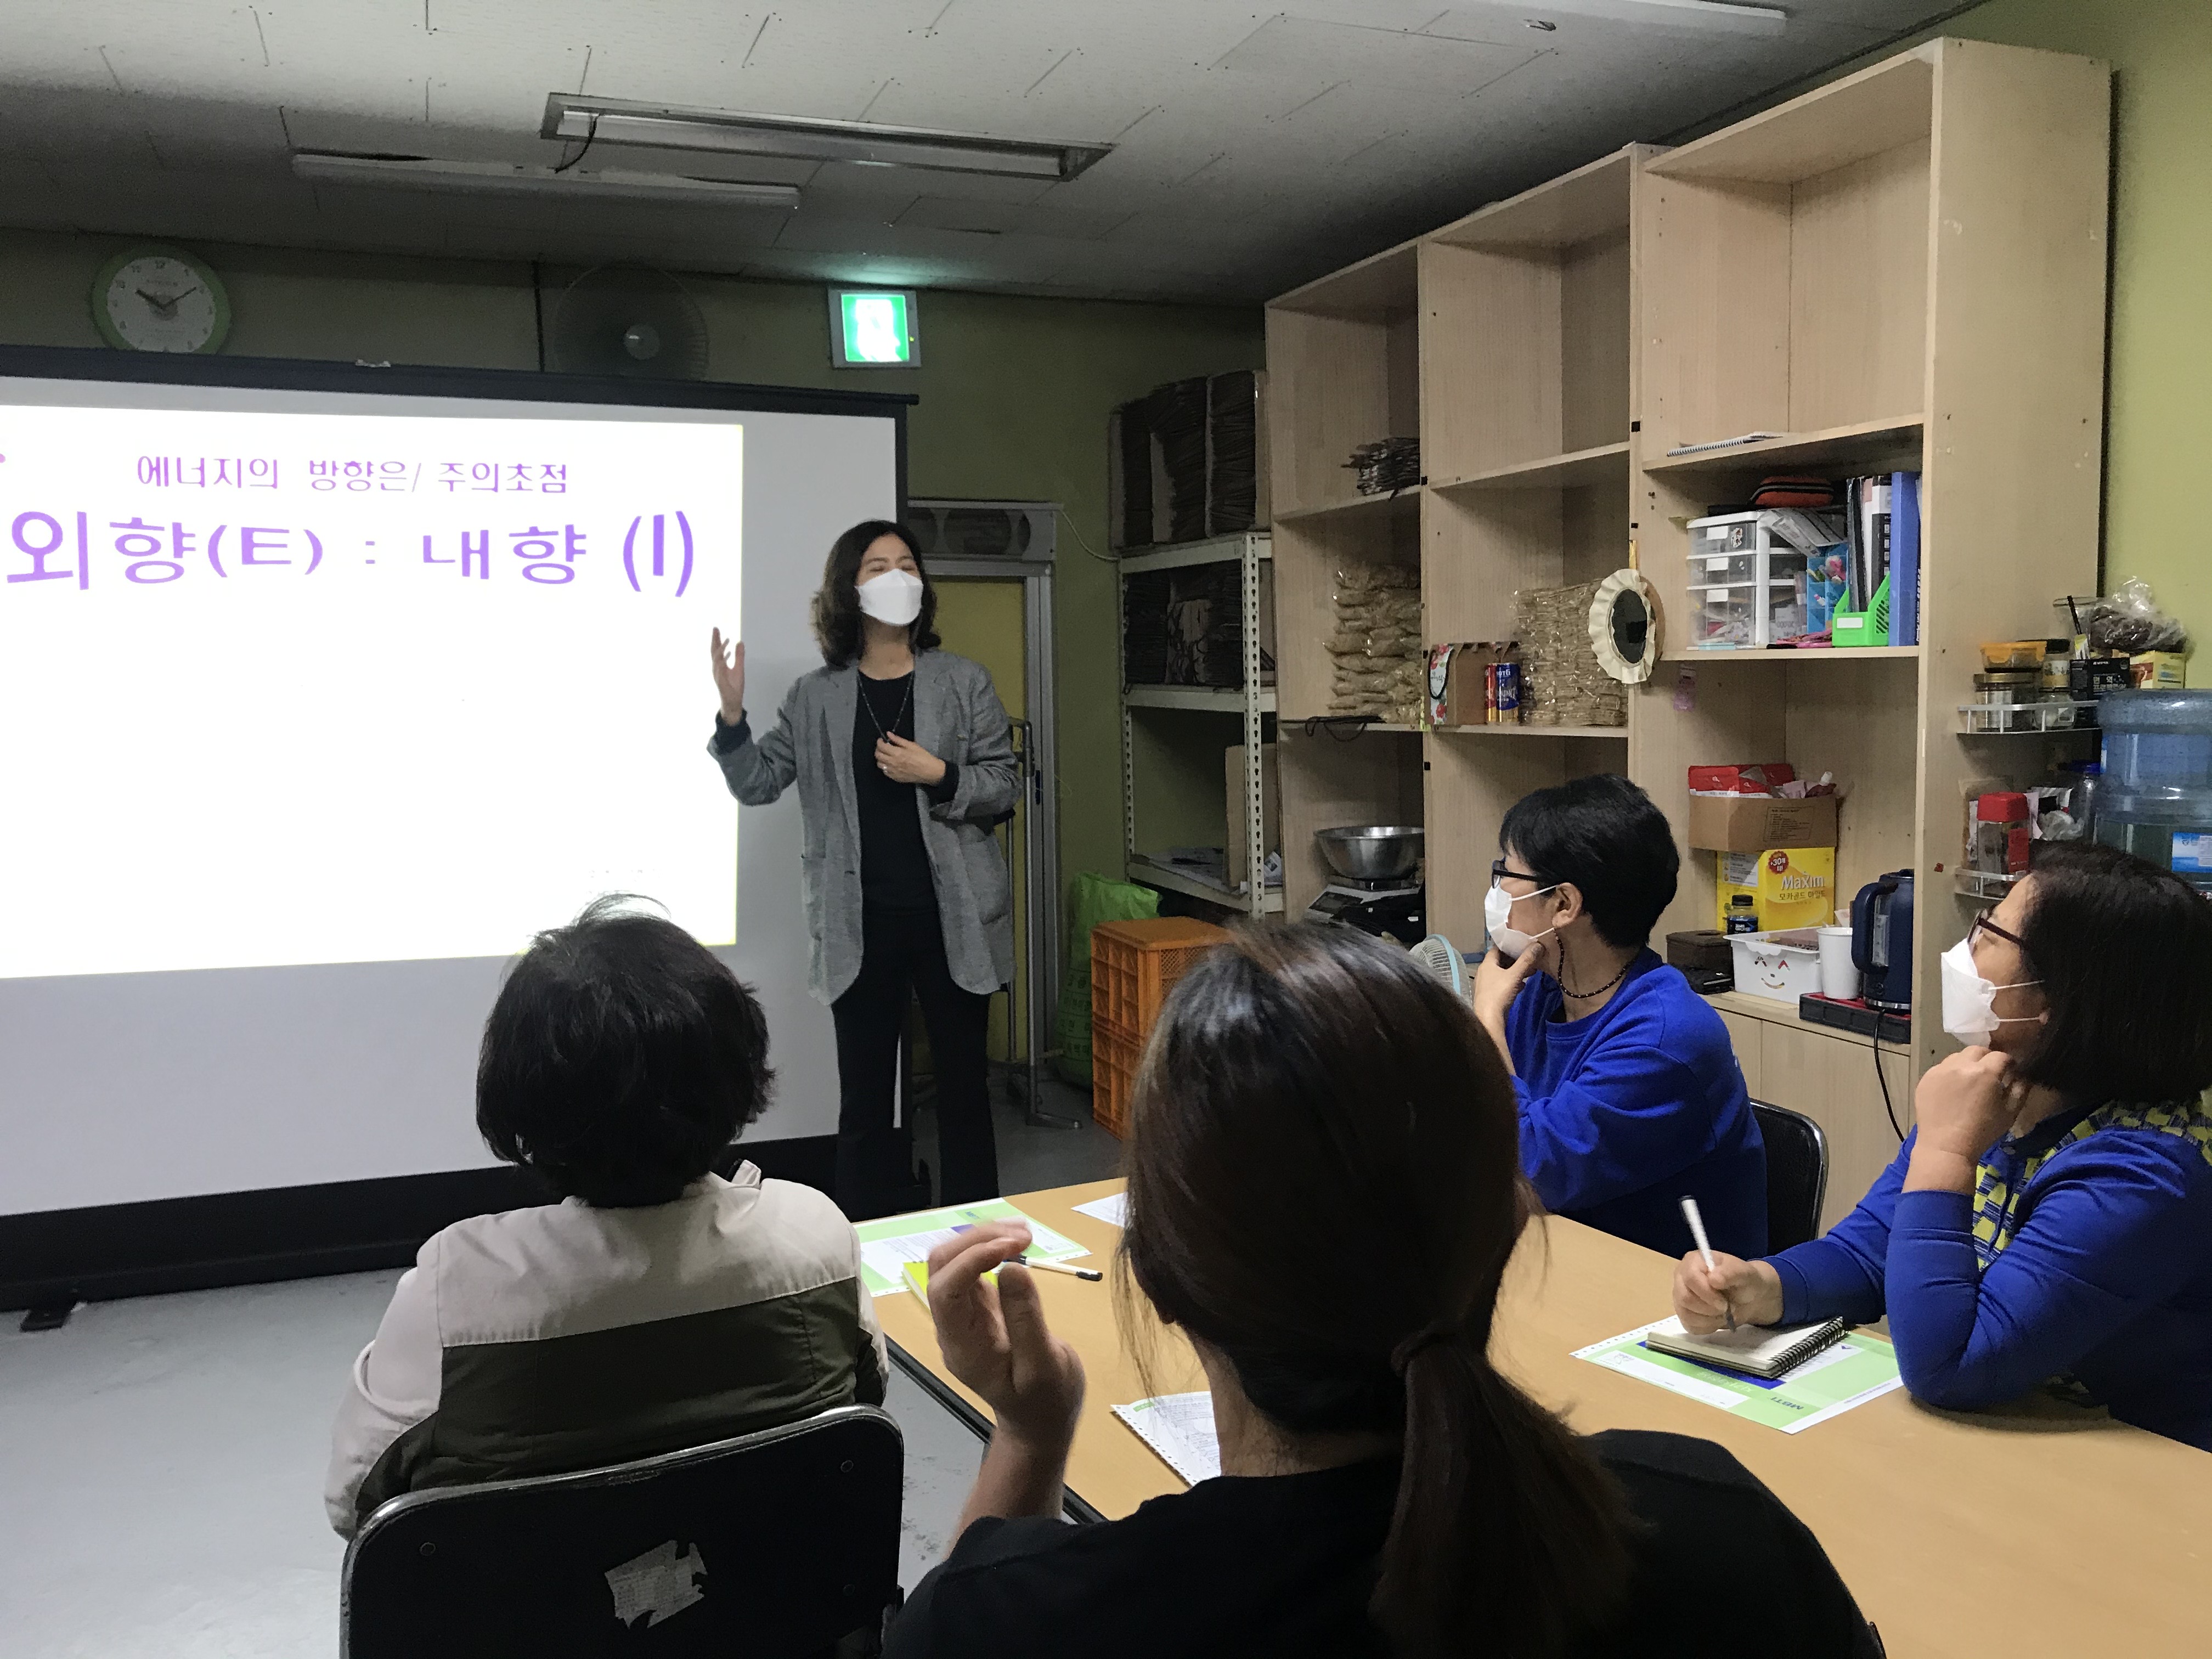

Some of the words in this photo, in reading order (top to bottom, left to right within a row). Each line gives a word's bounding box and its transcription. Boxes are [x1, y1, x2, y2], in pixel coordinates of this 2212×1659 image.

[137, 456, 279, 489] 에너지의
[437, 462, 567, 494] 주의초점
[7, 511, 323, 590] 외향(E)
[422, 524, 587, 585] 내향
[1781, 874, 1824, 890] Maxim
[1779, 891, 1806, 900] 모카골드
[1808, 889, 1827, 899] 마일드
[1770, 1397, 1804, 1410] MBTI
